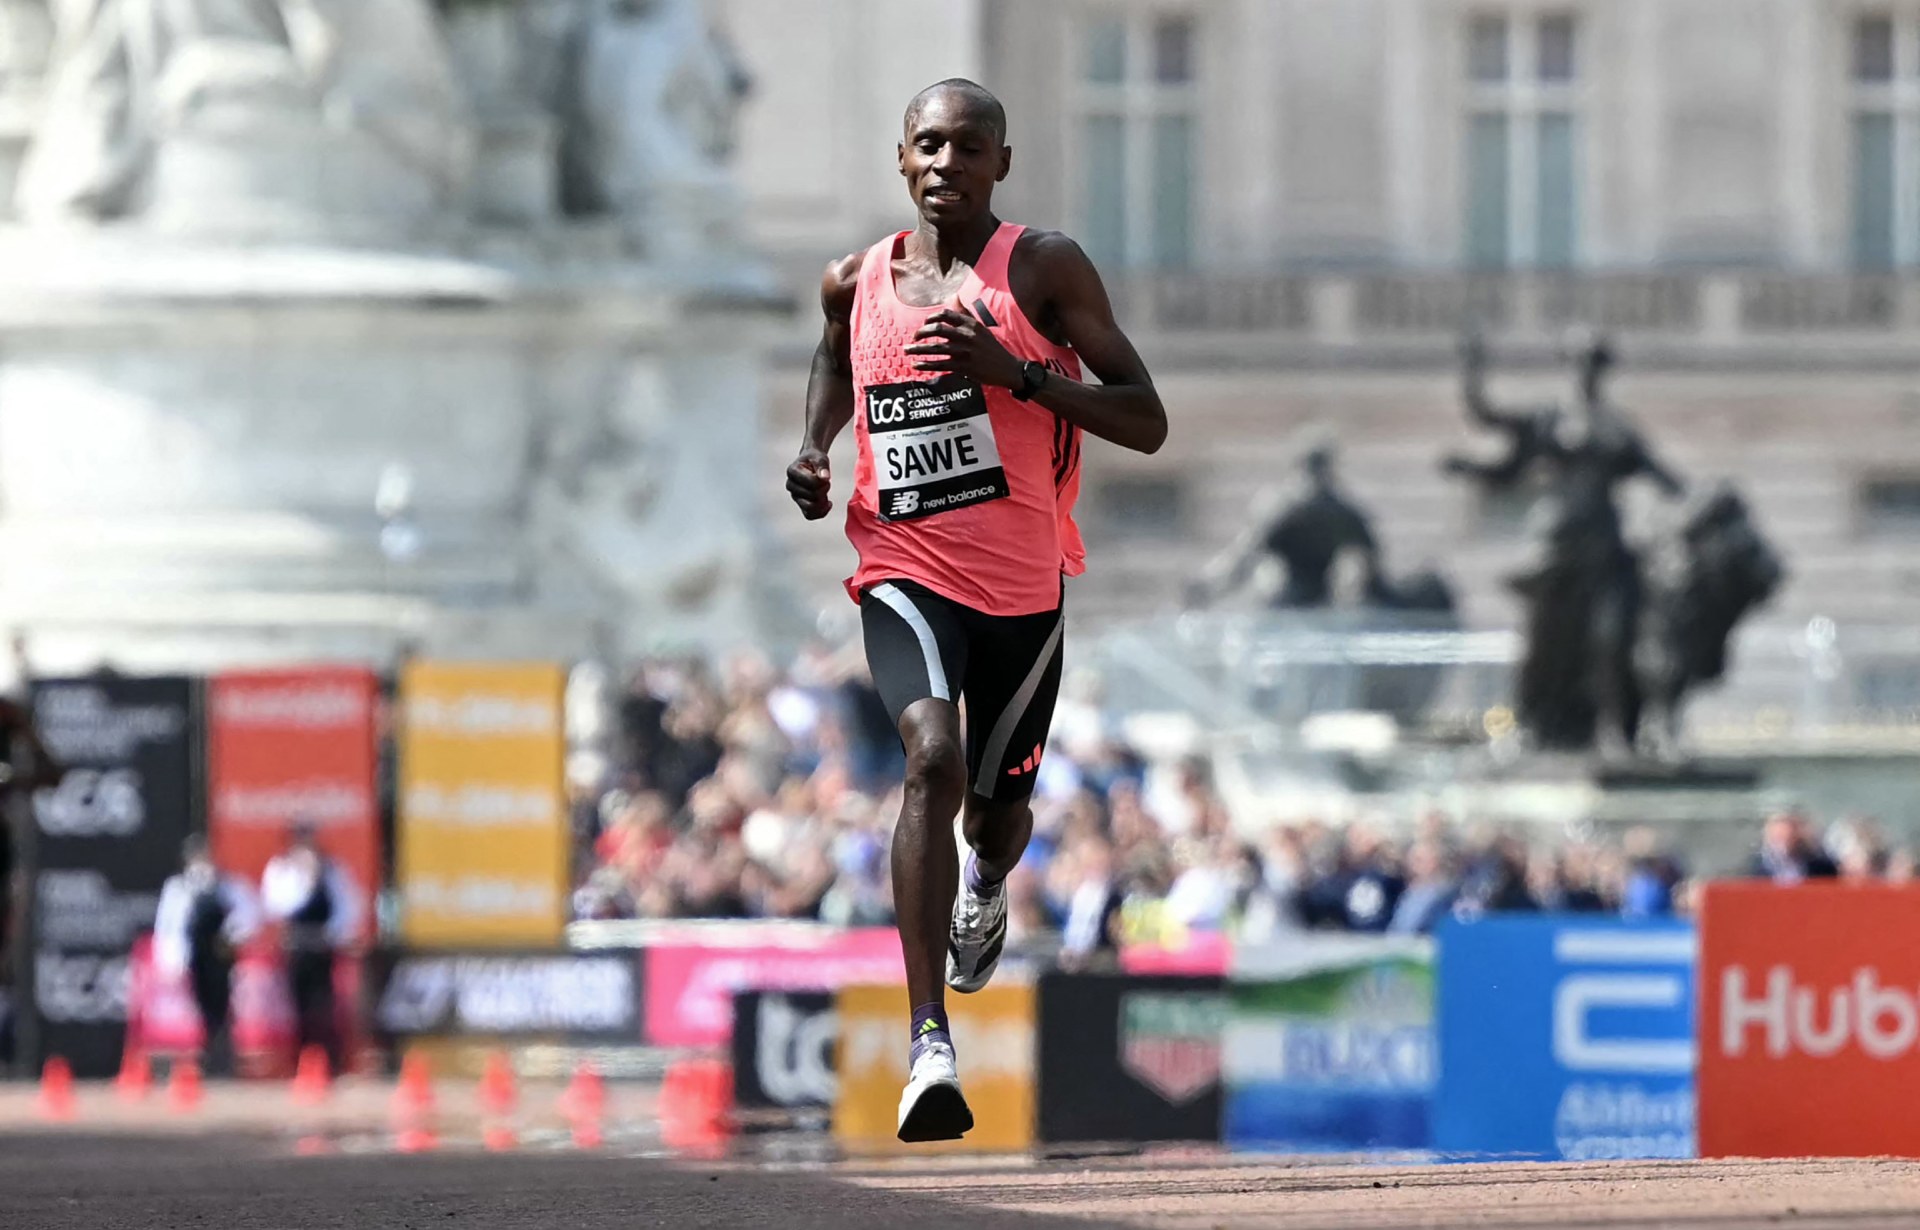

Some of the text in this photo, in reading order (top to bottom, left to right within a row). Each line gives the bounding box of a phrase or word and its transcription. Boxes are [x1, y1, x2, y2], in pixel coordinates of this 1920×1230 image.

[905, 387, 933, 399] TATA
[907, 387, 973, 409] CONSULTANCY
[869, 393, 905, 425] tcs
[908, 405, 951, 420] SERVICES
[886, 434, 979, 481] SAWE
[923, 497, 946, 510] new
[948, 485, 996, 504] balance
